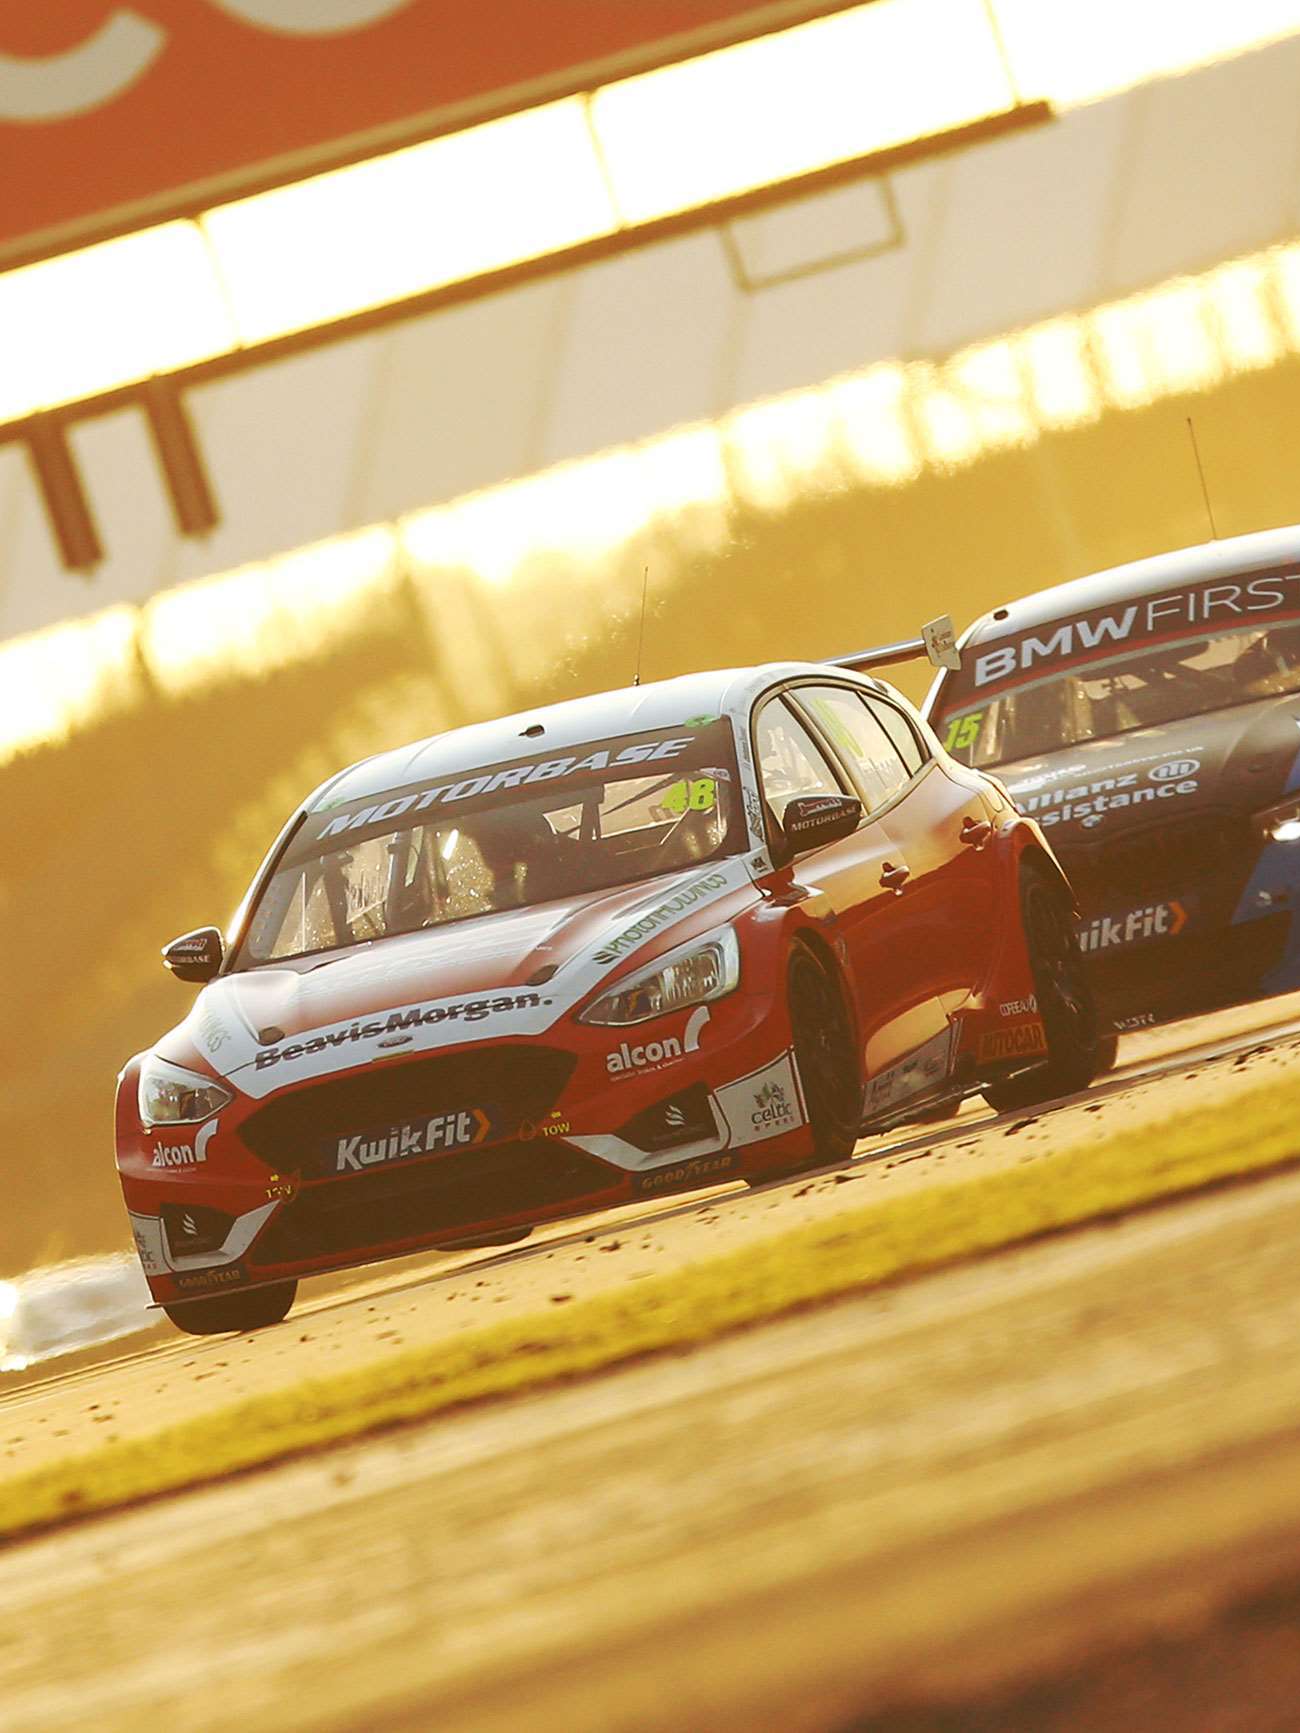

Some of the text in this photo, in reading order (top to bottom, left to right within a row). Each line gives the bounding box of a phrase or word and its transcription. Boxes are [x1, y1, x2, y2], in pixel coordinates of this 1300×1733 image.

[945, 712, 983, 753] 15
[316, 736, 696, 841] MOTORBASE
[605, 1034, 682, 1072] alcon
[542, 1121, 571, 1137] TOW
[152, 1140, 196, 1168] alcon
